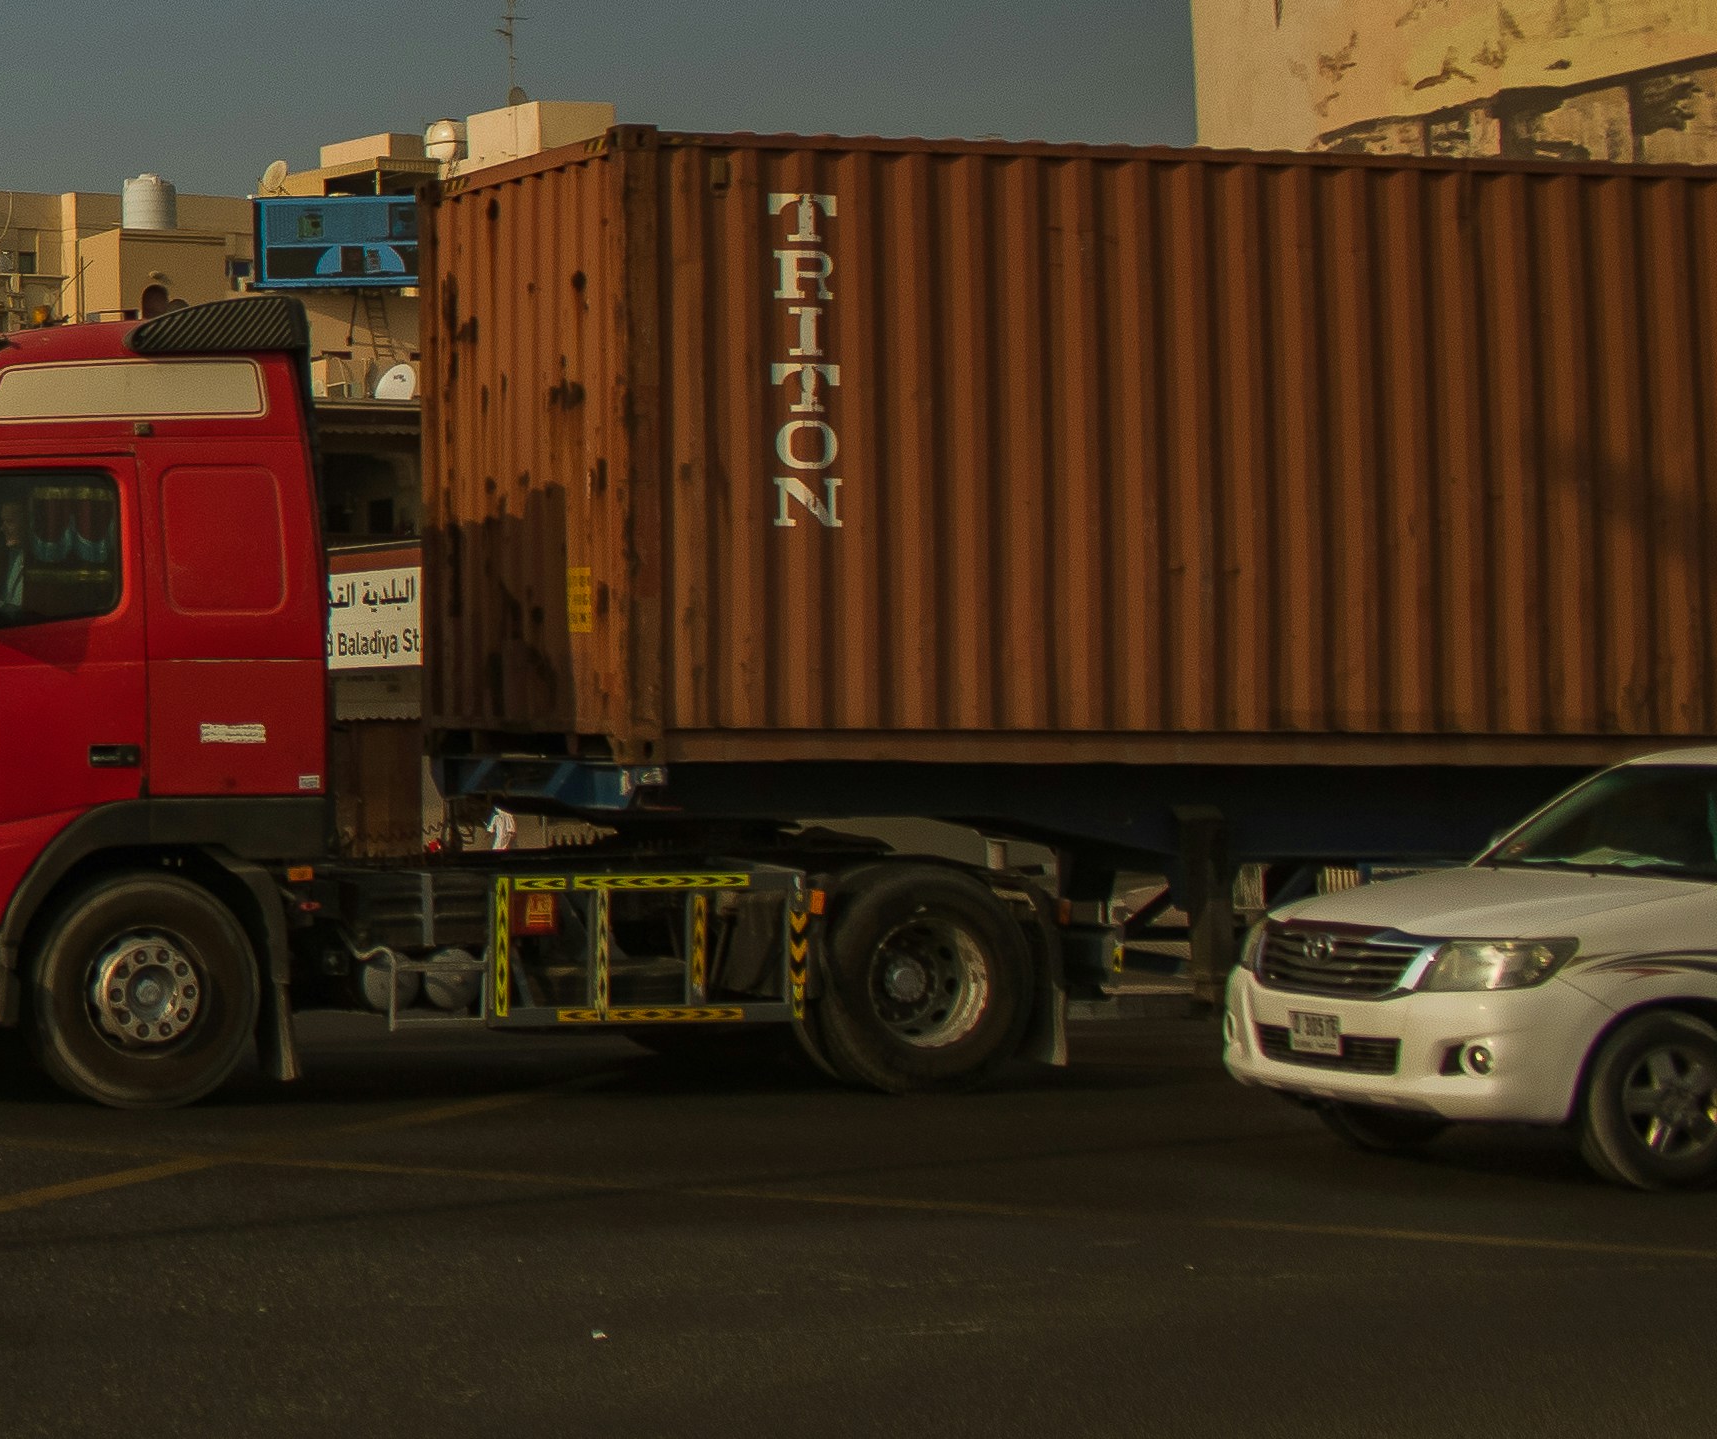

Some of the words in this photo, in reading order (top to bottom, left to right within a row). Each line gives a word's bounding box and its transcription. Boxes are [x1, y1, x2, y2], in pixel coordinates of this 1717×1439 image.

[767, 191, 843, 528] TRITON
[362, 574, 415, 614] البلدية
[338, 627, 399, 660] Baladiya
